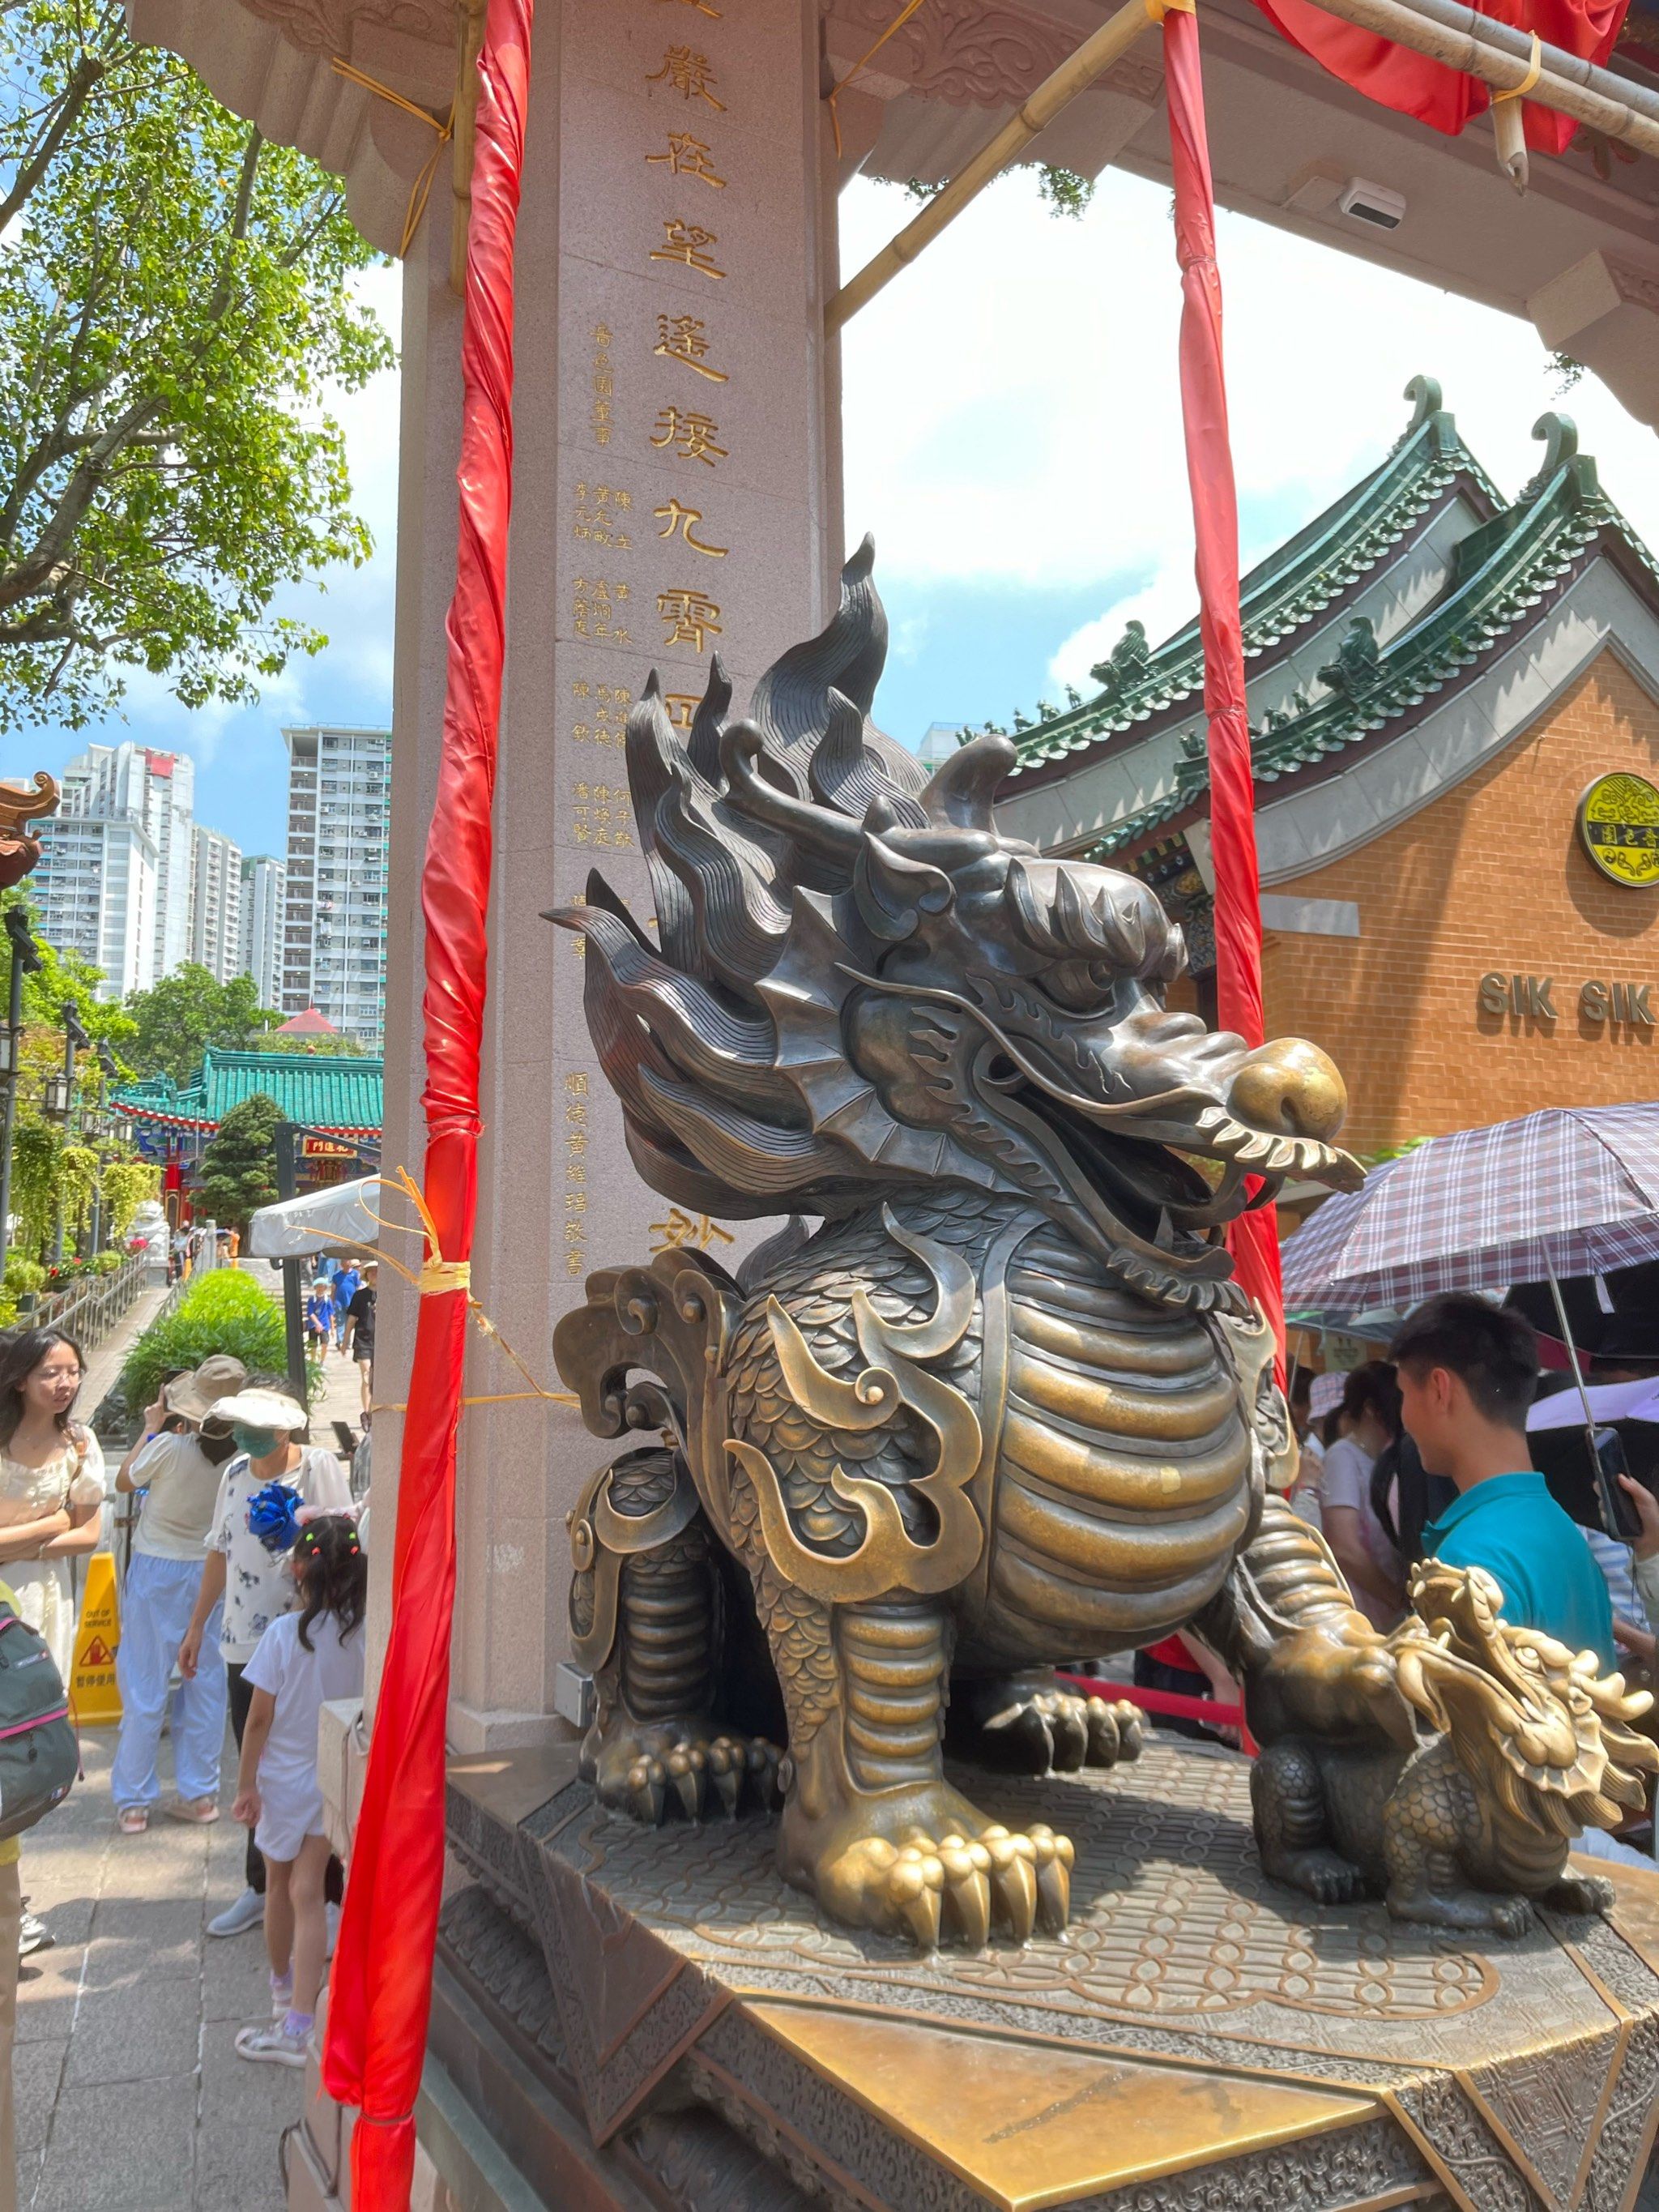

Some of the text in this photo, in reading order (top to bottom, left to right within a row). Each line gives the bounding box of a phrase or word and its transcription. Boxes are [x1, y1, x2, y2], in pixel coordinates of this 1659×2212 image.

[1482, 972, 1658, 1025] SIK SIK
[86, 1608, 110, 1619] OUT OF
[84, 1618, 112, 1629] SERVICE
